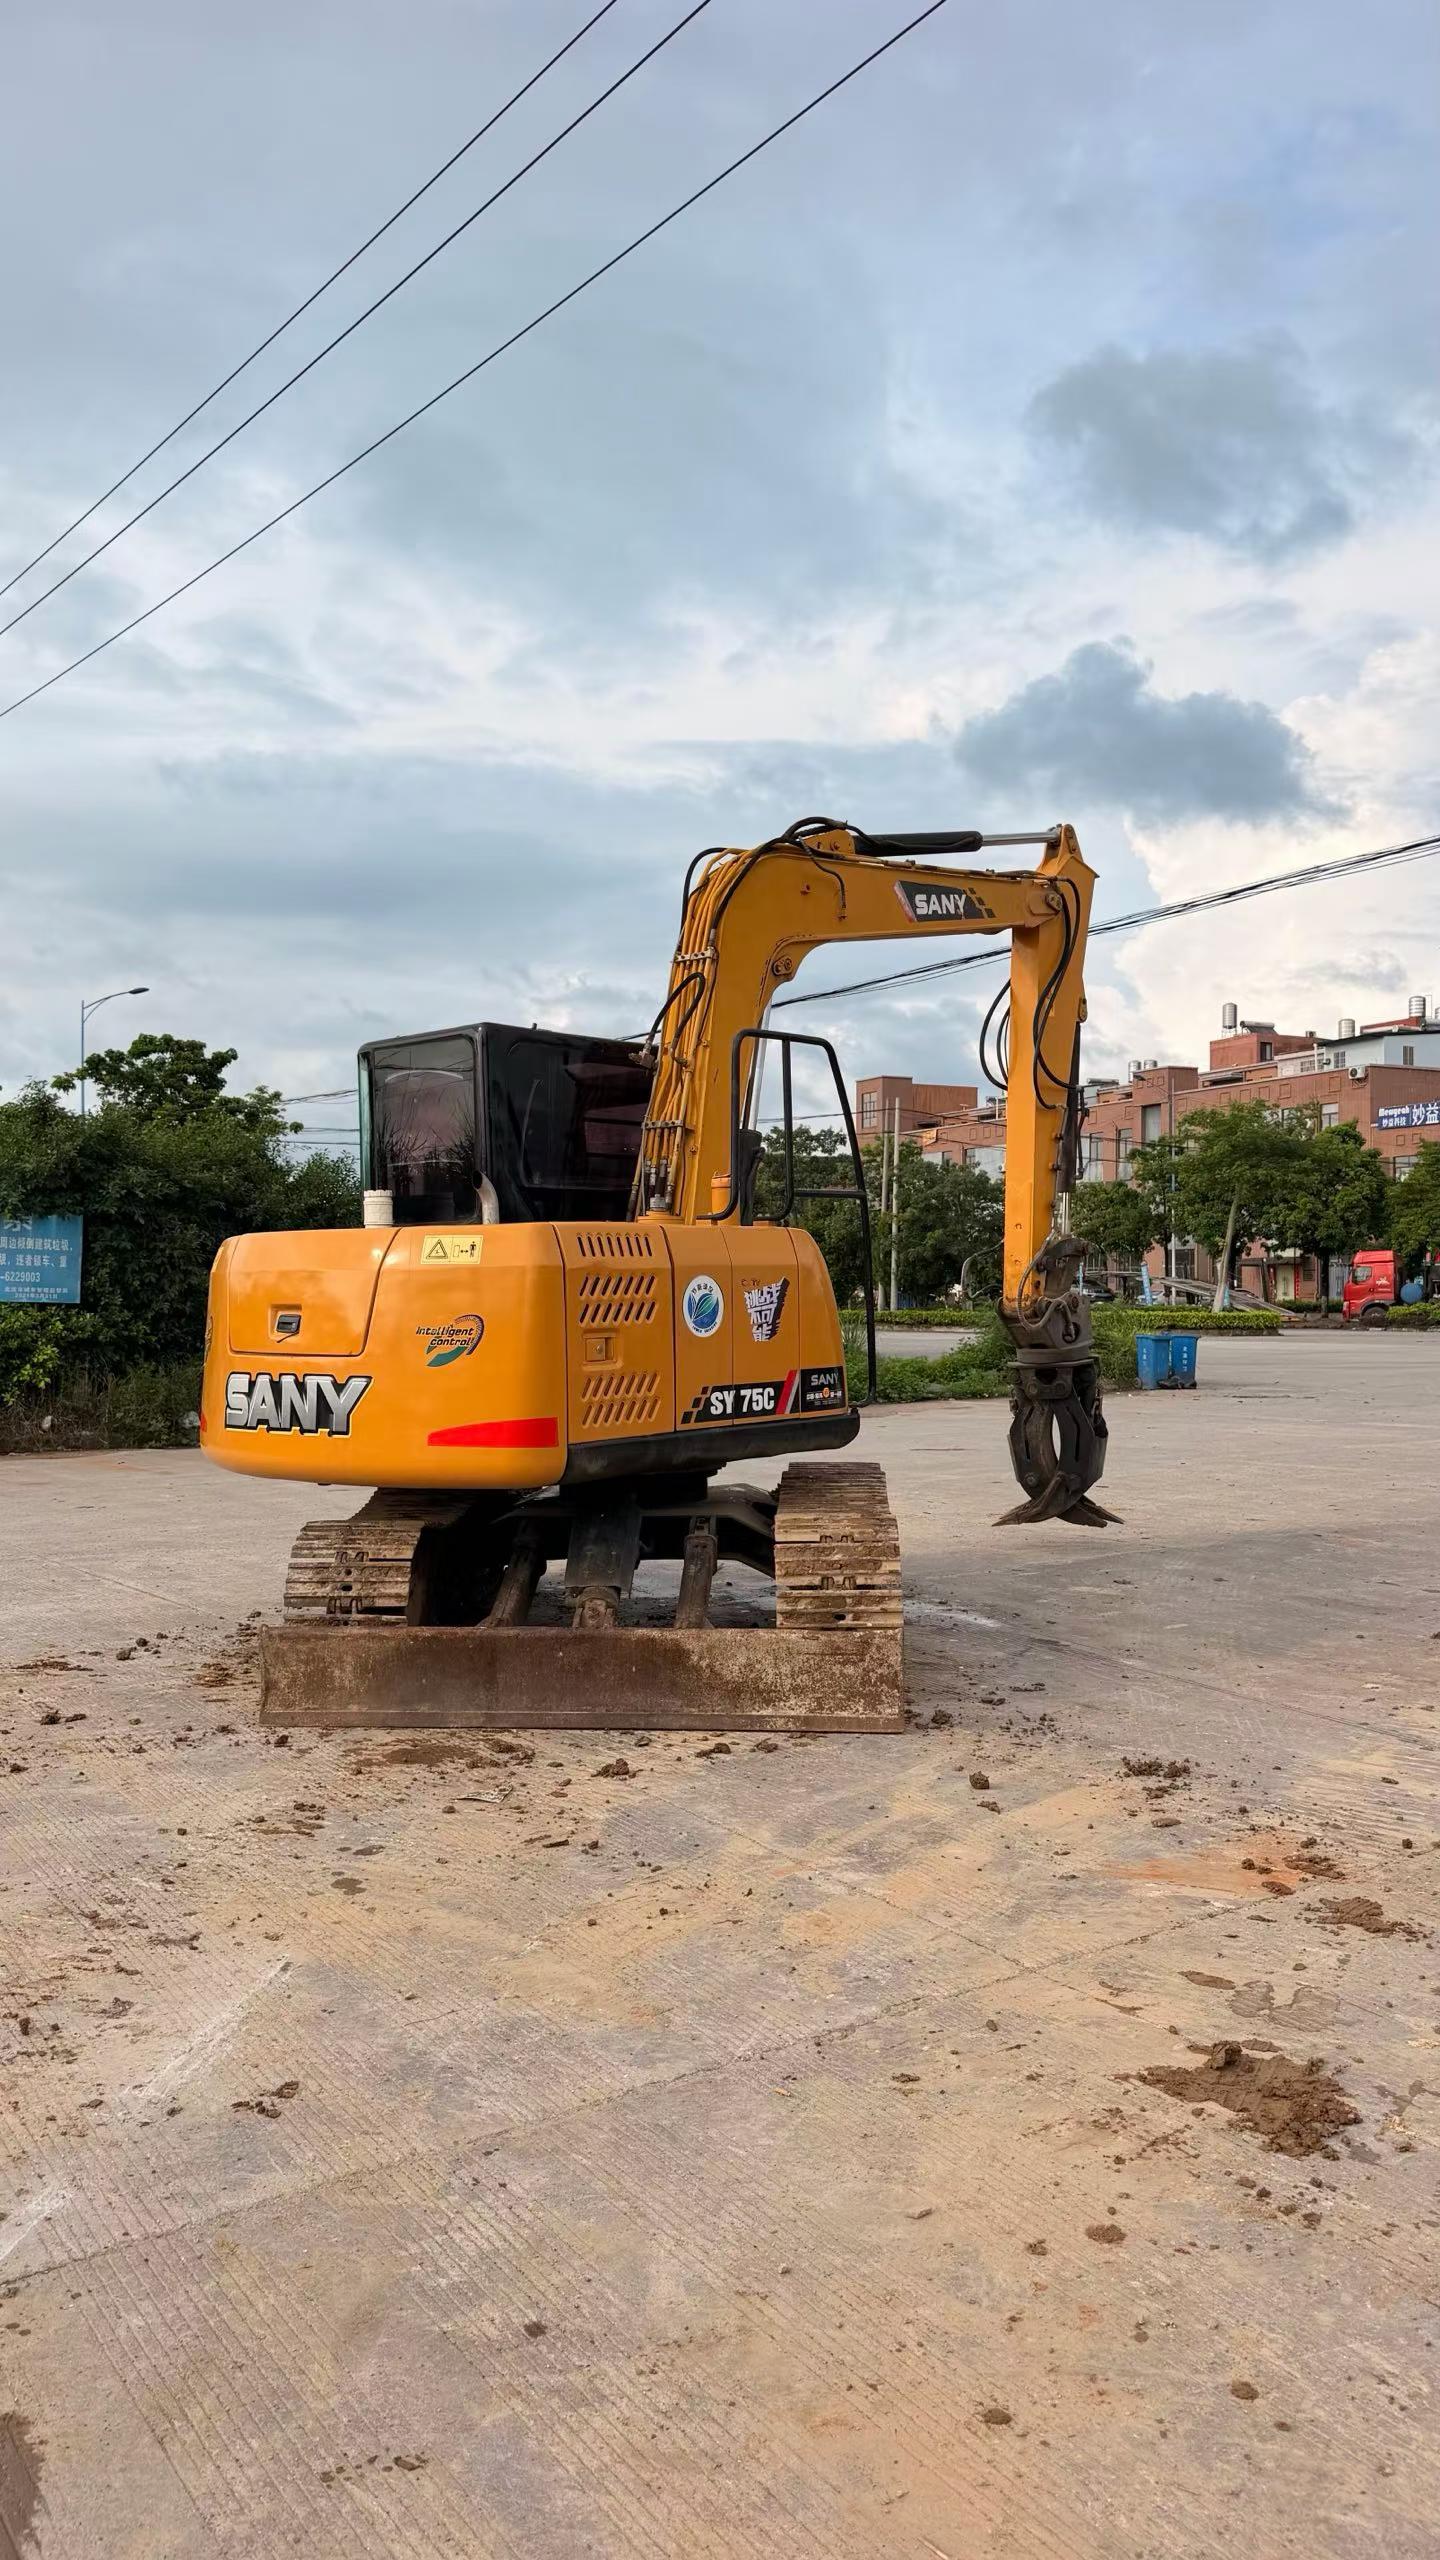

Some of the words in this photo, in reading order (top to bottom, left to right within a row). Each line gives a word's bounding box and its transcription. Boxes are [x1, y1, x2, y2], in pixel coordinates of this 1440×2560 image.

[914, 894, 967, 915] SANY
[1412, 1102, 1439, 1126] 妙益
[744, 1279, 783, 1308] 挑战
[430, 1338, 471, 1346] control
[810, 1373, 839, 1386] SANY
[225, 1371, 373, 1437] SANY
[710, 1389, 736, 1415] SY
[741, 1388, 775, 1413] 75C
